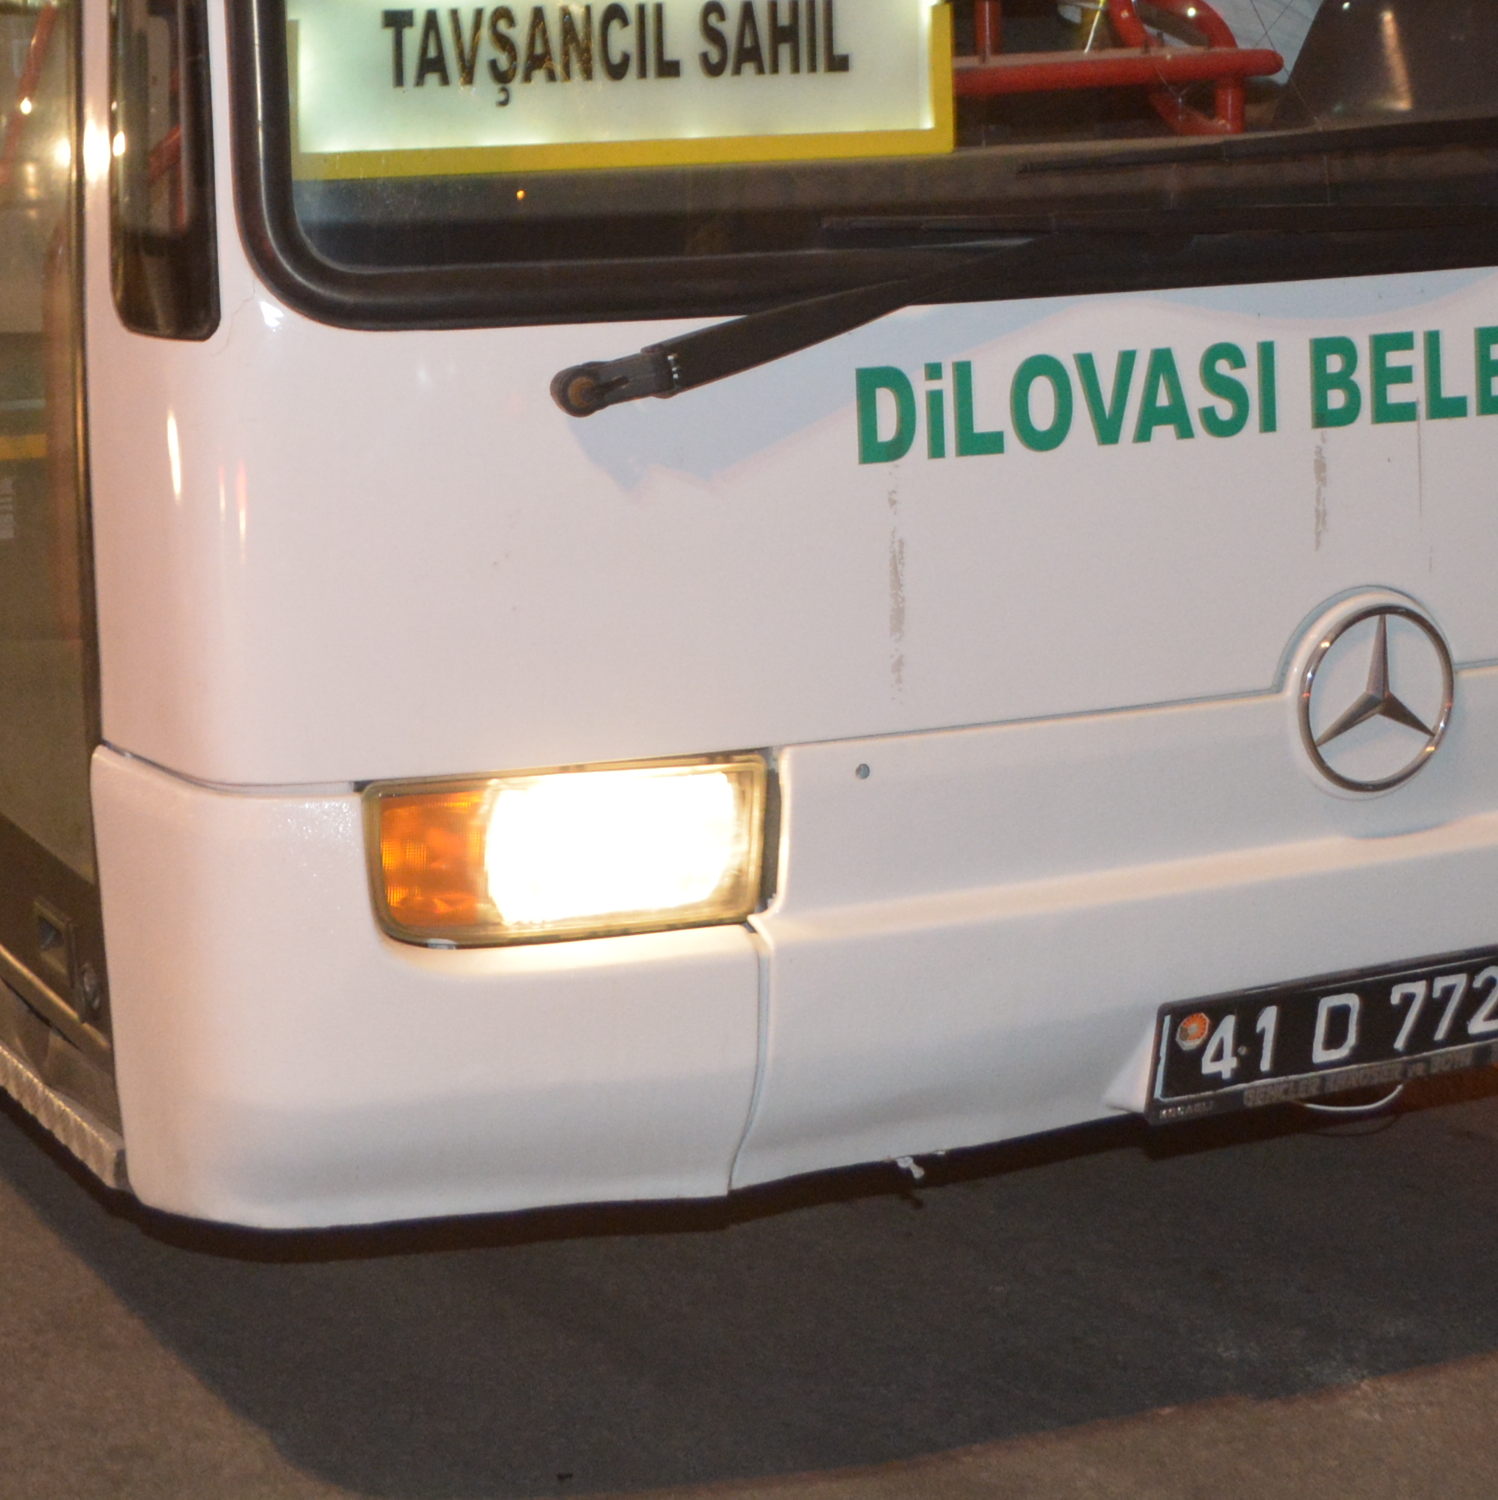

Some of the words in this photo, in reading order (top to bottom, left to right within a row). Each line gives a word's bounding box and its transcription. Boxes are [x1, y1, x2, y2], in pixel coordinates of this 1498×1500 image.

[381, 2, 681, 107] TAVŞANCIL
[1201, 1005, 1279, 1081] 41
[1312, 993, 1362, 1064] D
